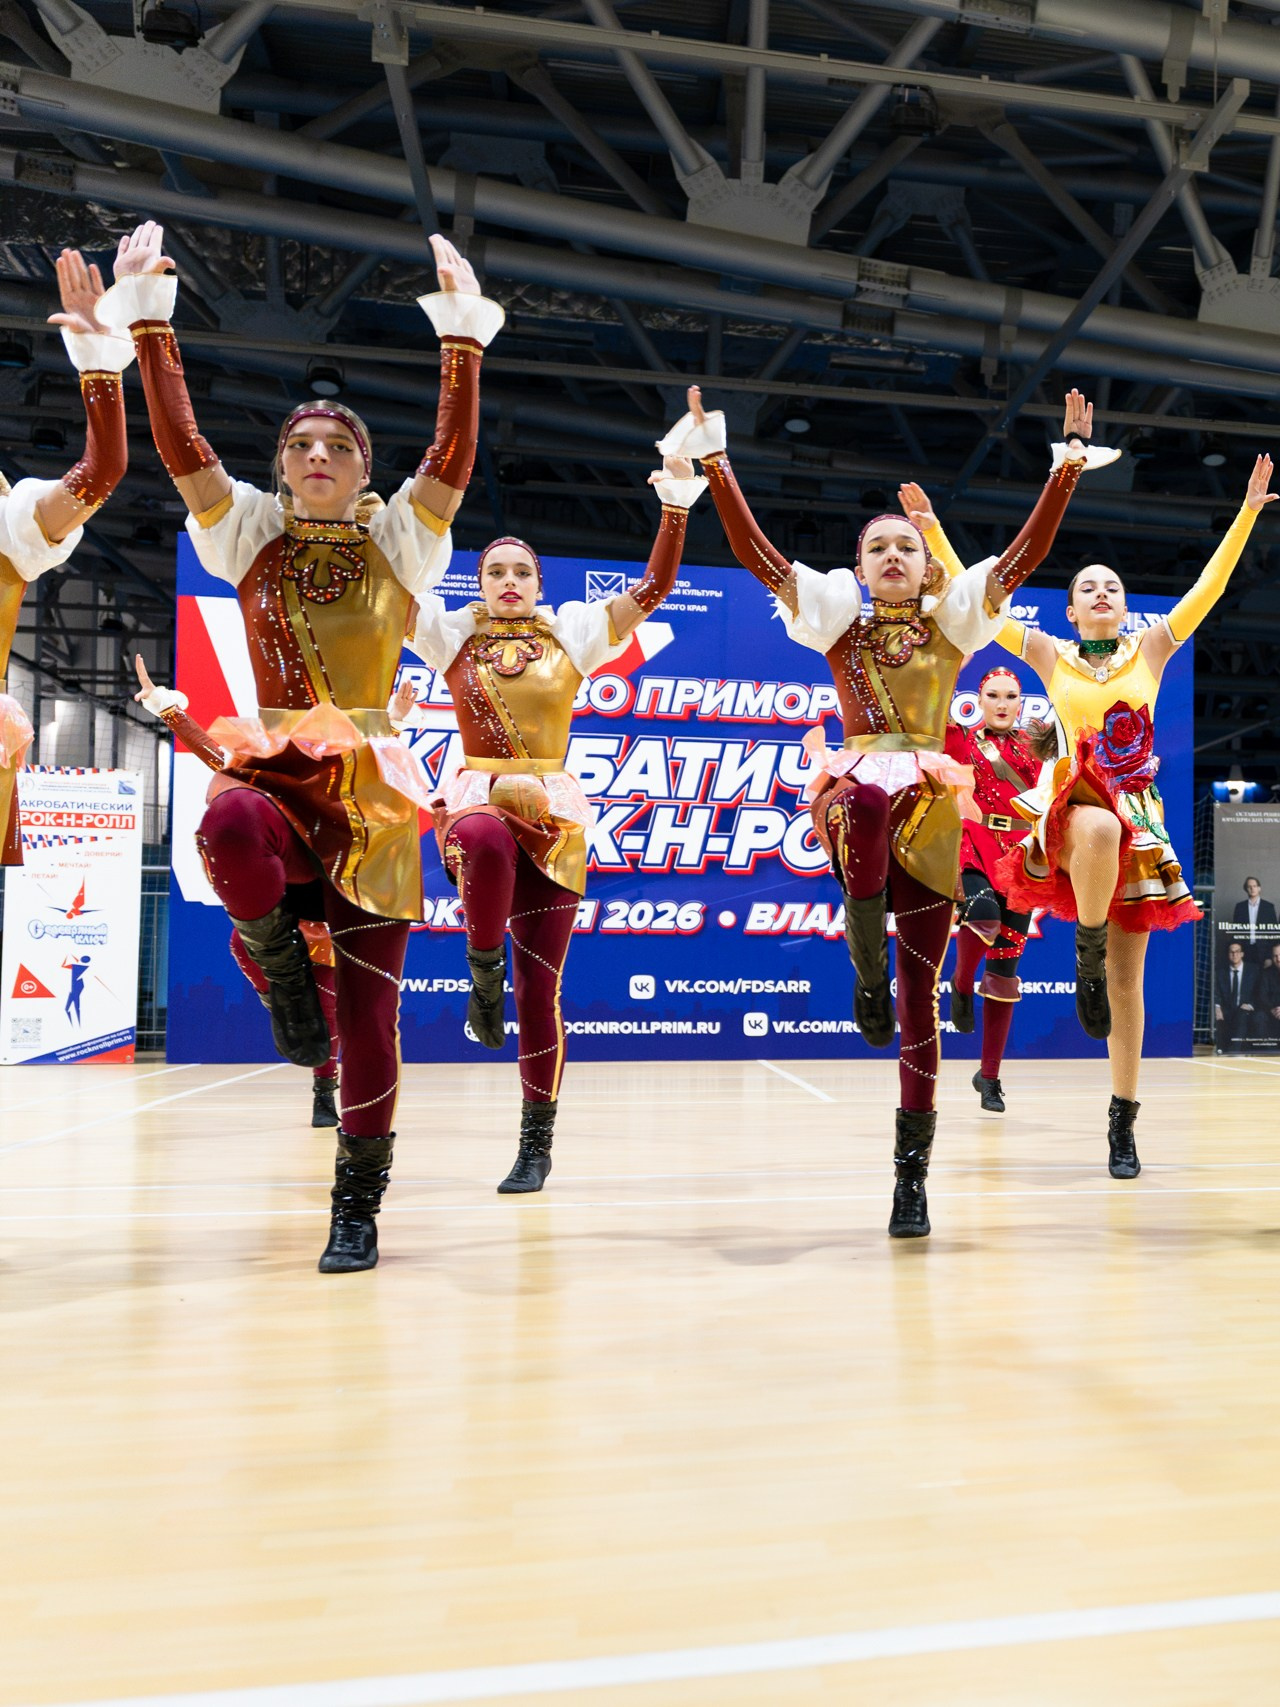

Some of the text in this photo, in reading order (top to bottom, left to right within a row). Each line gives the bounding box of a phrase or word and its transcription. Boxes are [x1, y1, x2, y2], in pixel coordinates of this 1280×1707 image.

[682, 588, 723, 597] КУЛЬТУРЫ
[687, 604, 708, 612] КРАЯ
[20, 800, 133, 811] АКРОБАТИЧЕСКИЙ
[20, 811, 134, 828] РОК-Н-РОЛЛ
[600, 899, 706, 932] 2026
[664, 978, 811, 994] VK.COM/FDSARR
